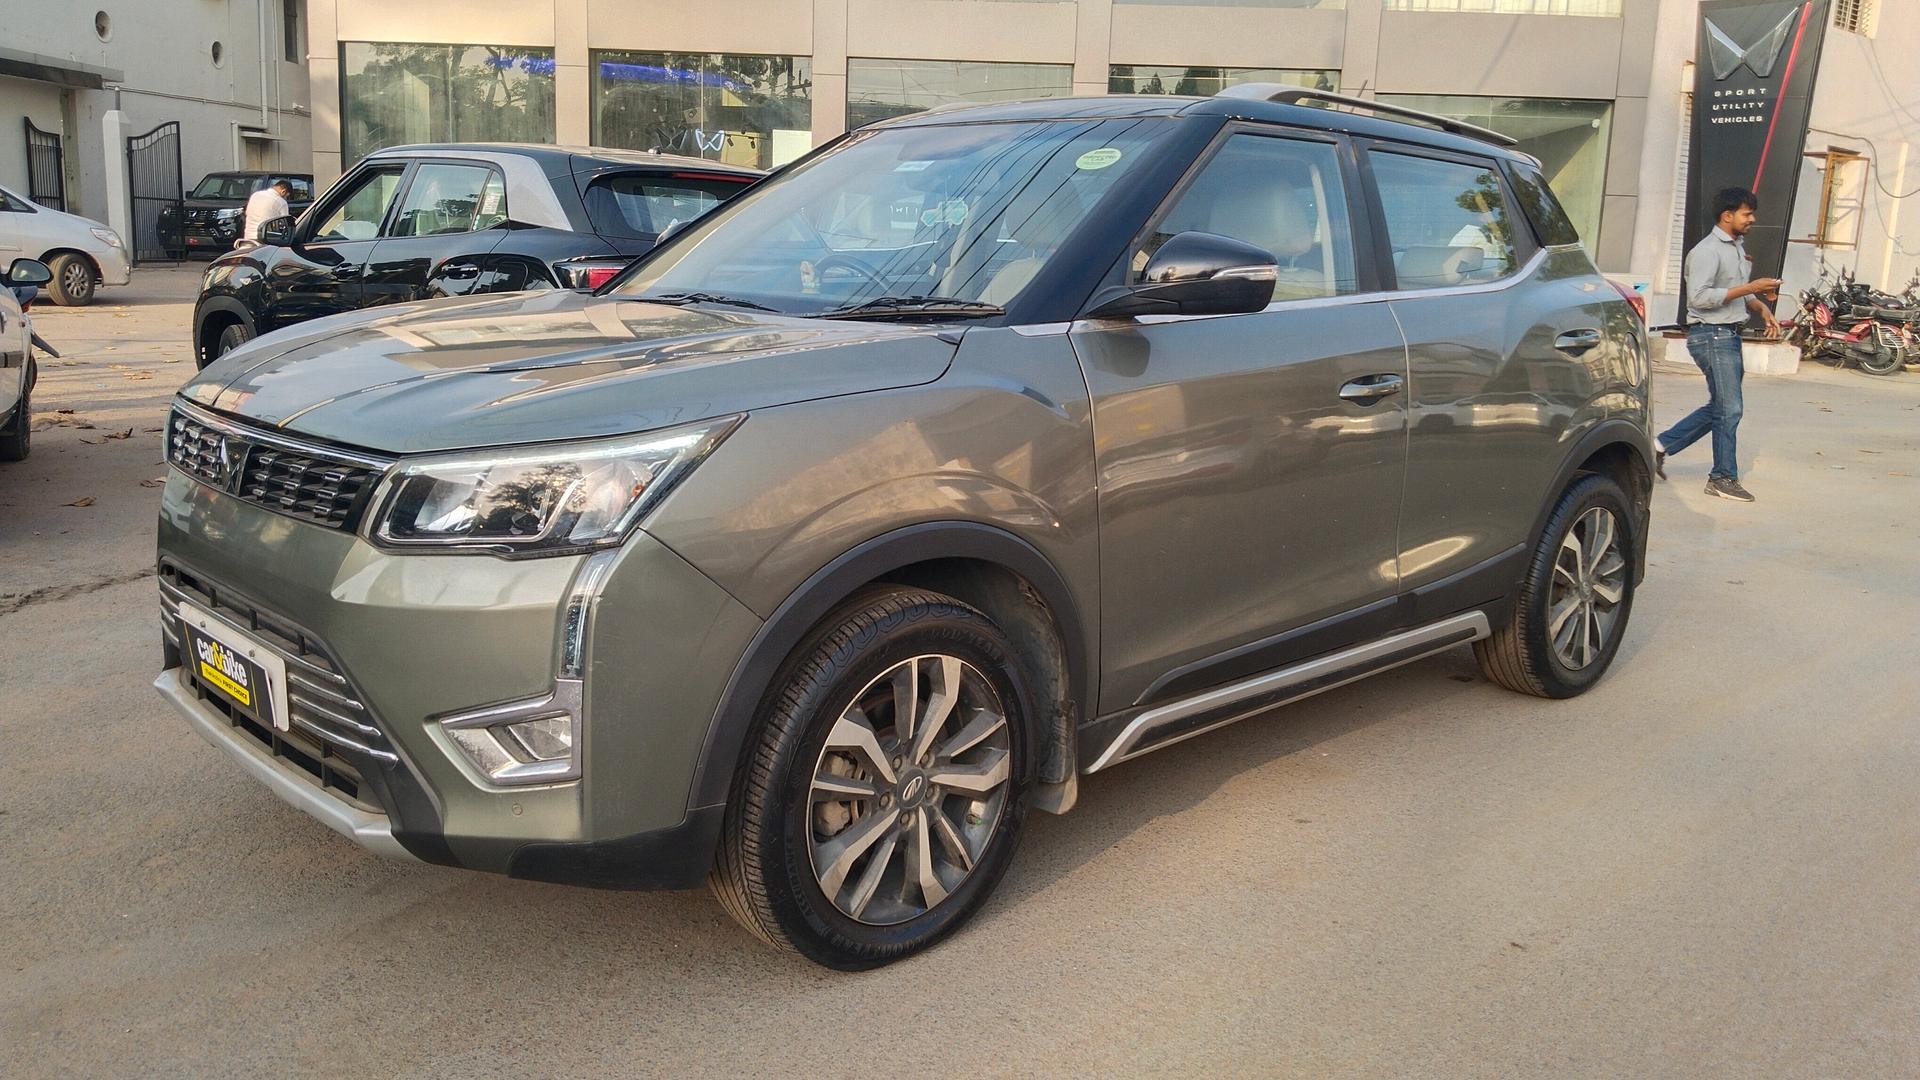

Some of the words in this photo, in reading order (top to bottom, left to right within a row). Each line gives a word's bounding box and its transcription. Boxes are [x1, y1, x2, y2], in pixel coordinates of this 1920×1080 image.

[1714, 88, 1767, 98] SPORT
[1712, 102, 1764, 111] UTILITY
[1711, 115, 1763, 124] VEHICLES
